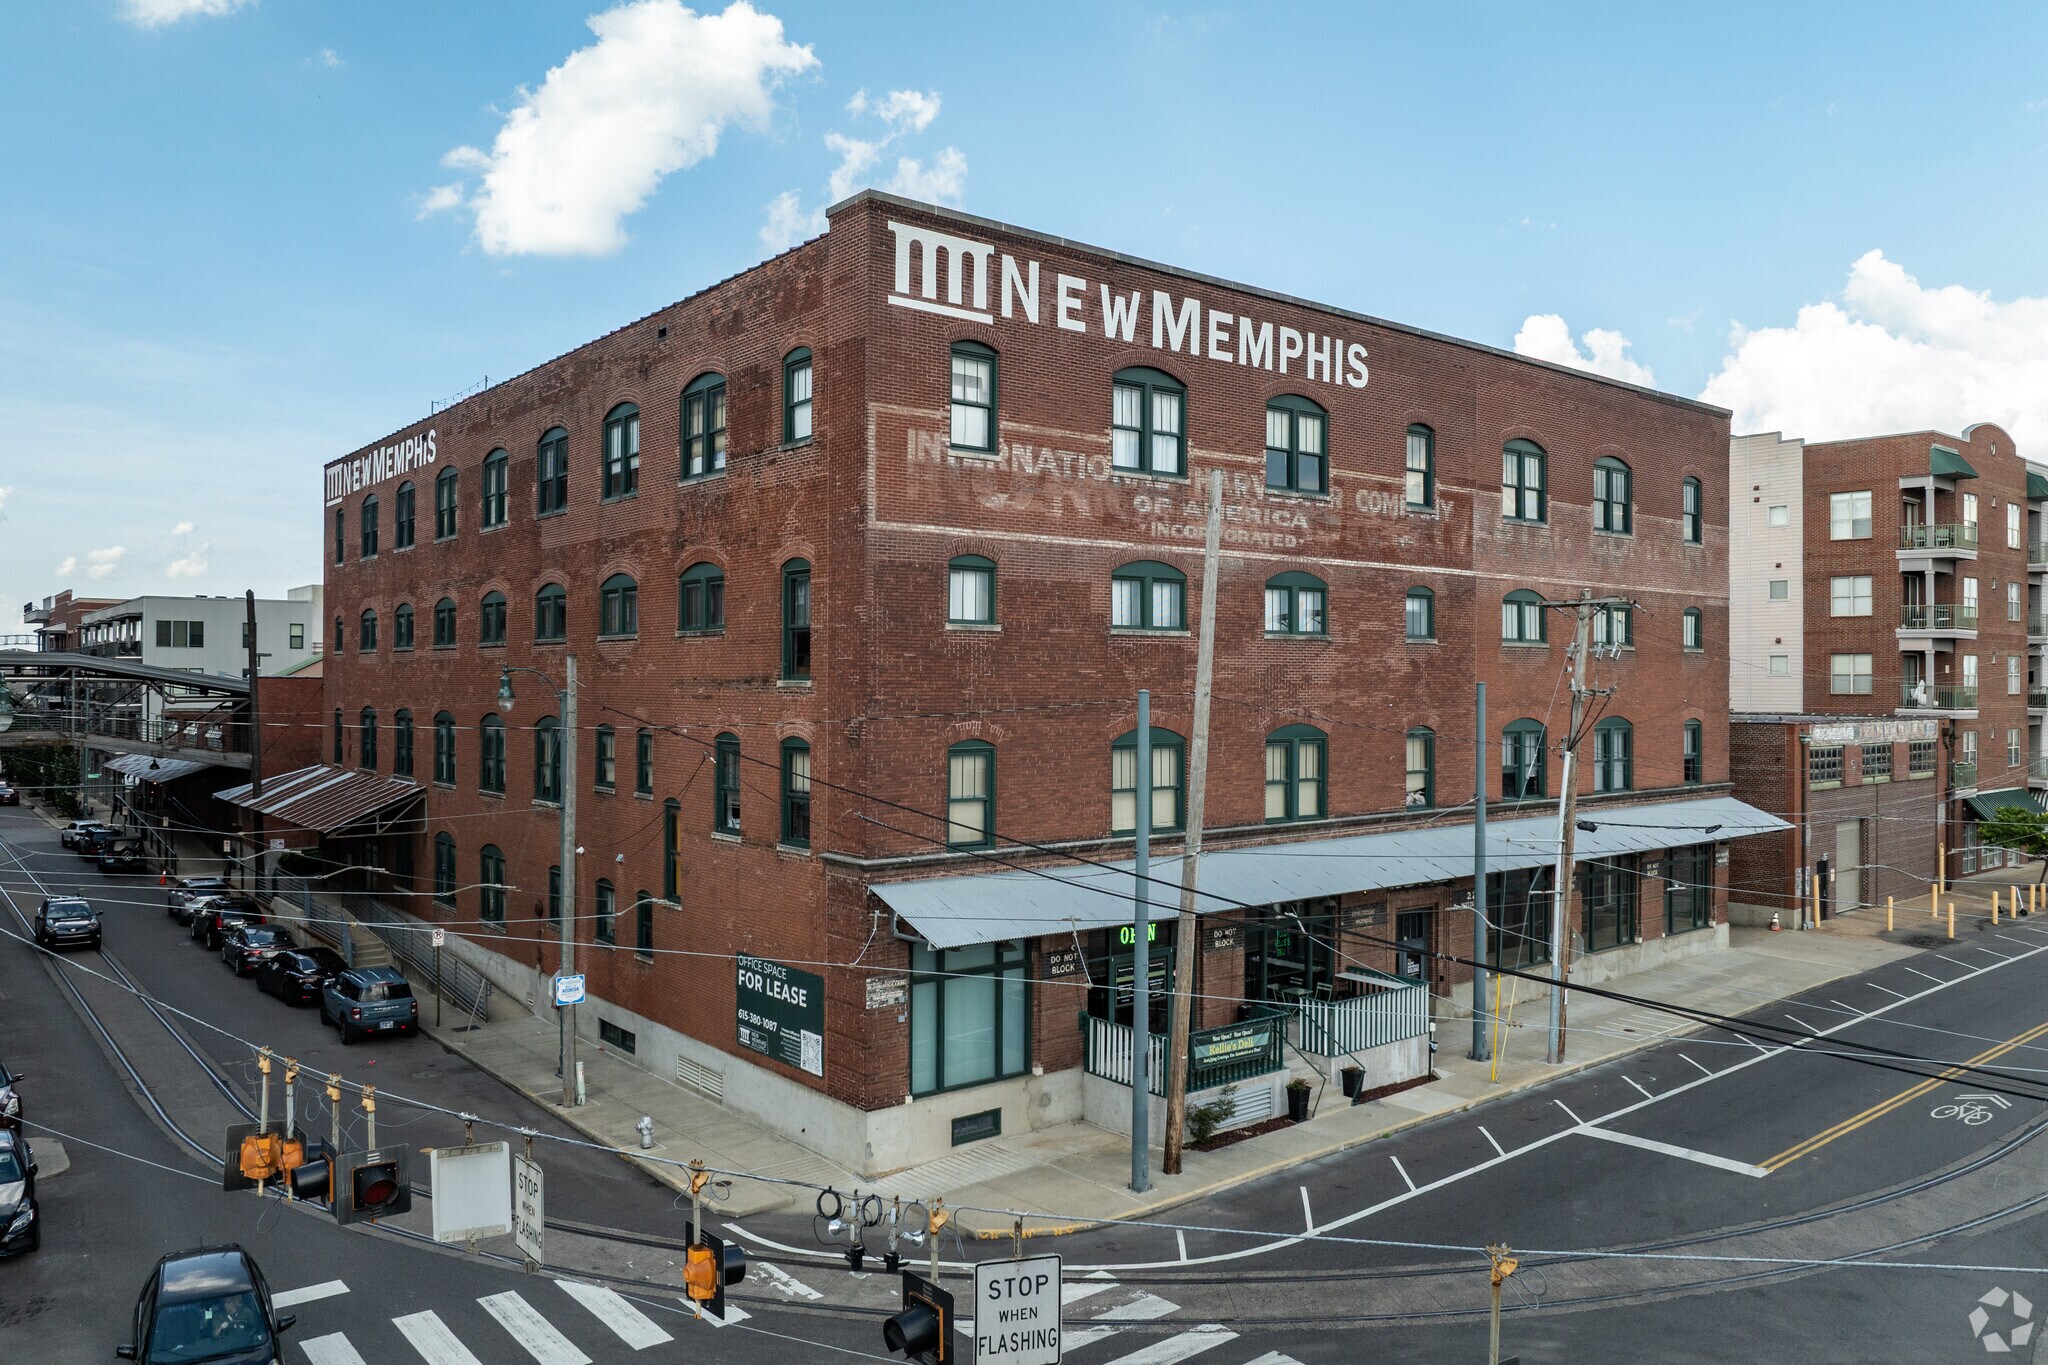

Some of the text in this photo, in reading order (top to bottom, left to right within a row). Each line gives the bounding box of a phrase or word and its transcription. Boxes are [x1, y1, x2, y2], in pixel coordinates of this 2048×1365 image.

[1152, 289, 1370, 389] MEMPHIS
[1182, 500, 1310, 530] AERICA
[1214, 937, 1235, 948] BLOCK
[738, 955, 787, 980] OFFICE SPACE
[1050, 952, 1078, 964] DO NOT
[1051, 963, 1076, 975] BLOCK
[738, 968, 808, 1008] FOR LEASE
[738, 1008, 778, 1032] 615-380-1087
[1209, 1036, 1254, 1055] Kellie's Deli
[518, 1172, 539, 1199] STOP
[522, 1200, 536, 1218] WHEN
[516, 1215, 542, 1250] FLASHING
[988, 1274, 1049, 1300] STOP
[999, 1306, 1038, 1323] WHEN
[978, 1327, 1058, 1357] FLASHING
